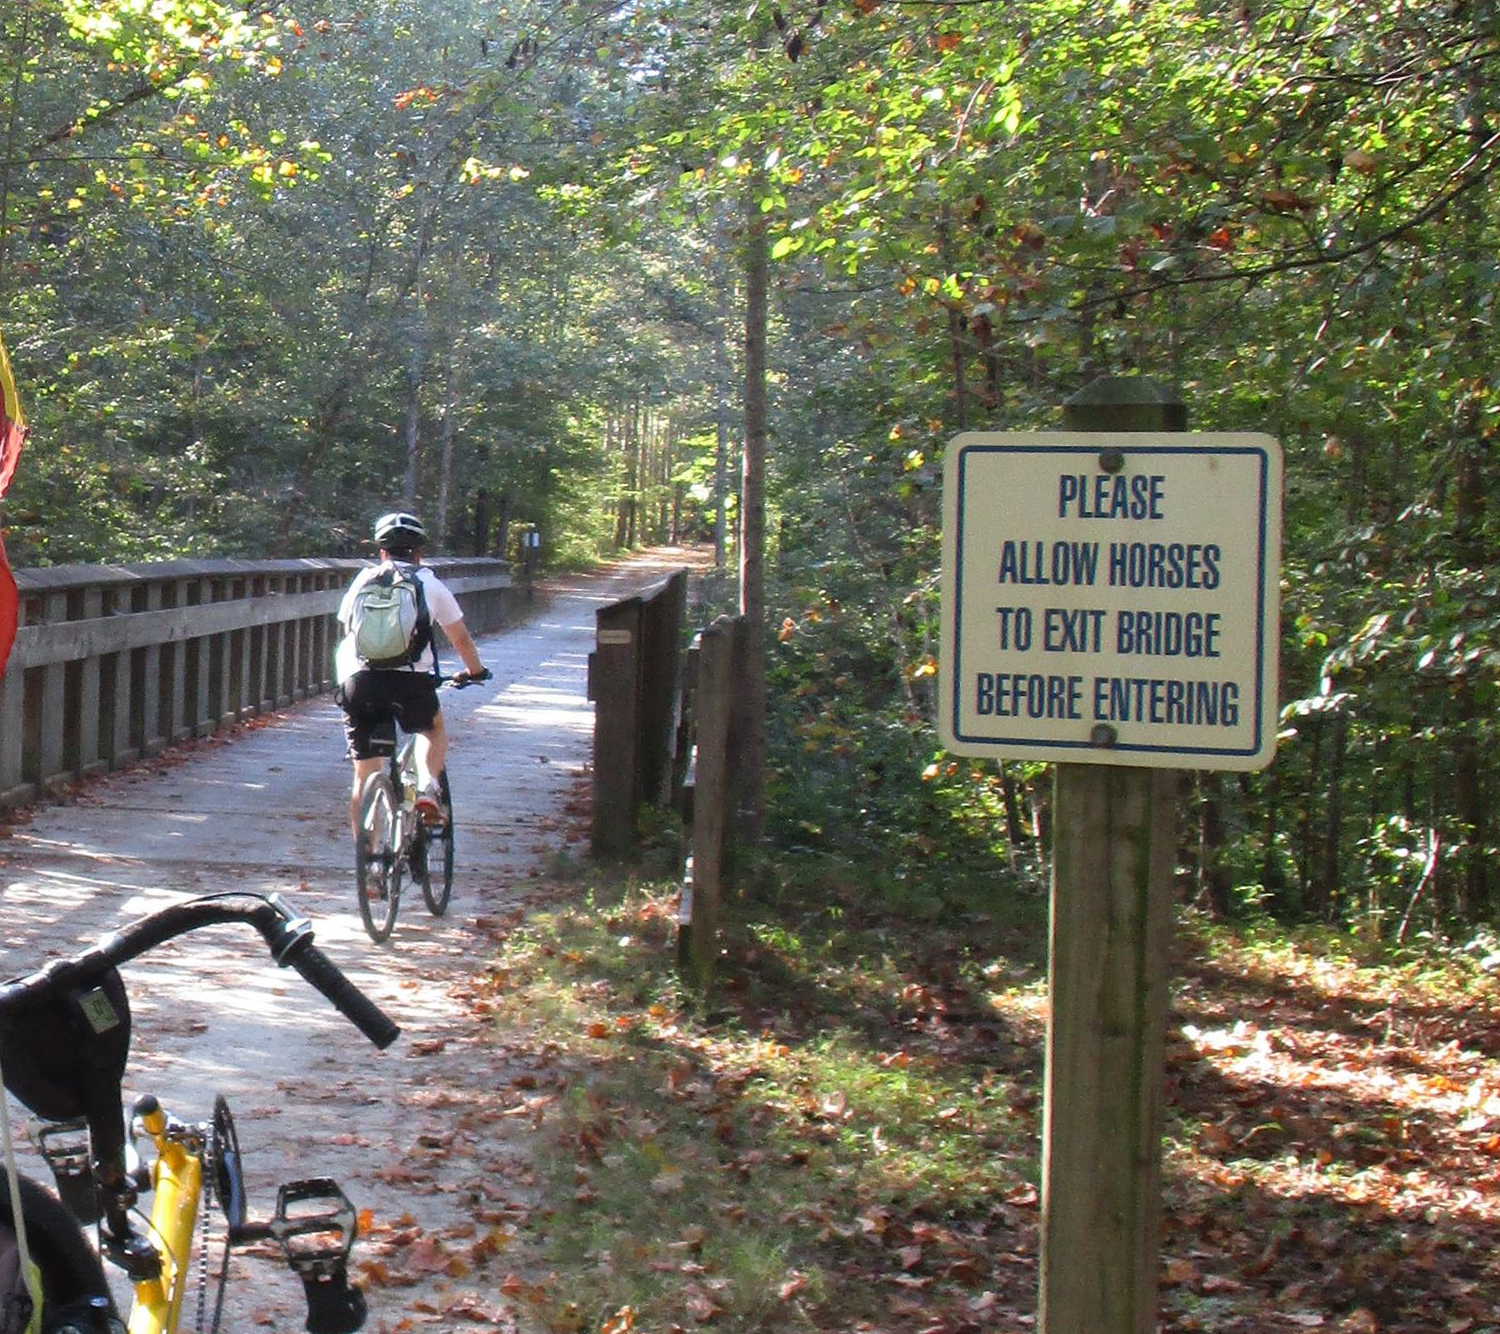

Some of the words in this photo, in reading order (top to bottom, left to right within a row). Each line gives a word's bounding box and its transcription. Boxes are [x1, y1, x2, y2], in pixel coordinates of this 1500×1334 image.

[1059, 475, 1165, 520] PLEASE
[999, 541, 1099, 586] ALLOW
[1109, 543, 1221, 589] HORSES
[997, 607, 1032, 651] TO
[1044, 608, 1106, 653] EXIT
[1117, 610, 1221, 657] BRIDGE
[977, 673, 1082, 719] BEFORE
[1094, 677, 1238, 726] ENTERING
